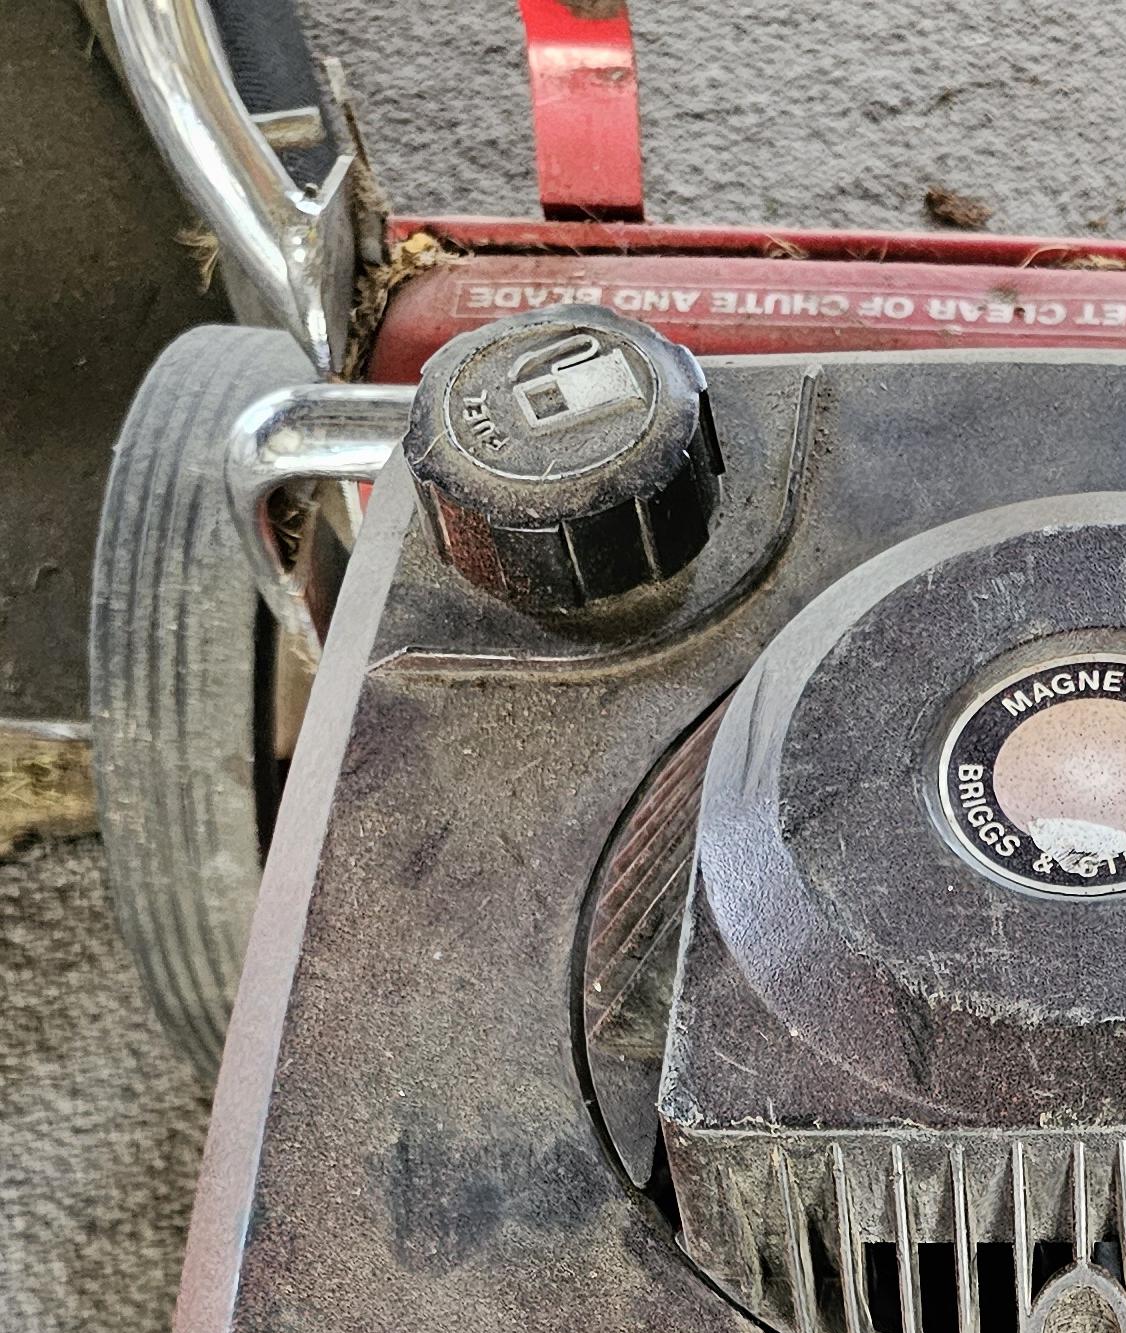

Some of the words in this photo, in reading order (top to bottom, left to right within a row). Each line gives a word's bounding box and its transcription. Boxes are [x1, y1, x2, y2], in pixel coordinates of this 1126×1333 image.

[468, 286, 603, 308] BLADE
[612, 288, 702, 313] AND
[709, 290, 850, 317] CHUTE
[857, 296, 915, 319] OF
[926, 299, 1066, 325] CLEAR
[463, 388, 510, 452] FUEL
[958, 763, 1021, 858] BRIGGS
[1032, 853, 1054, 875] &
